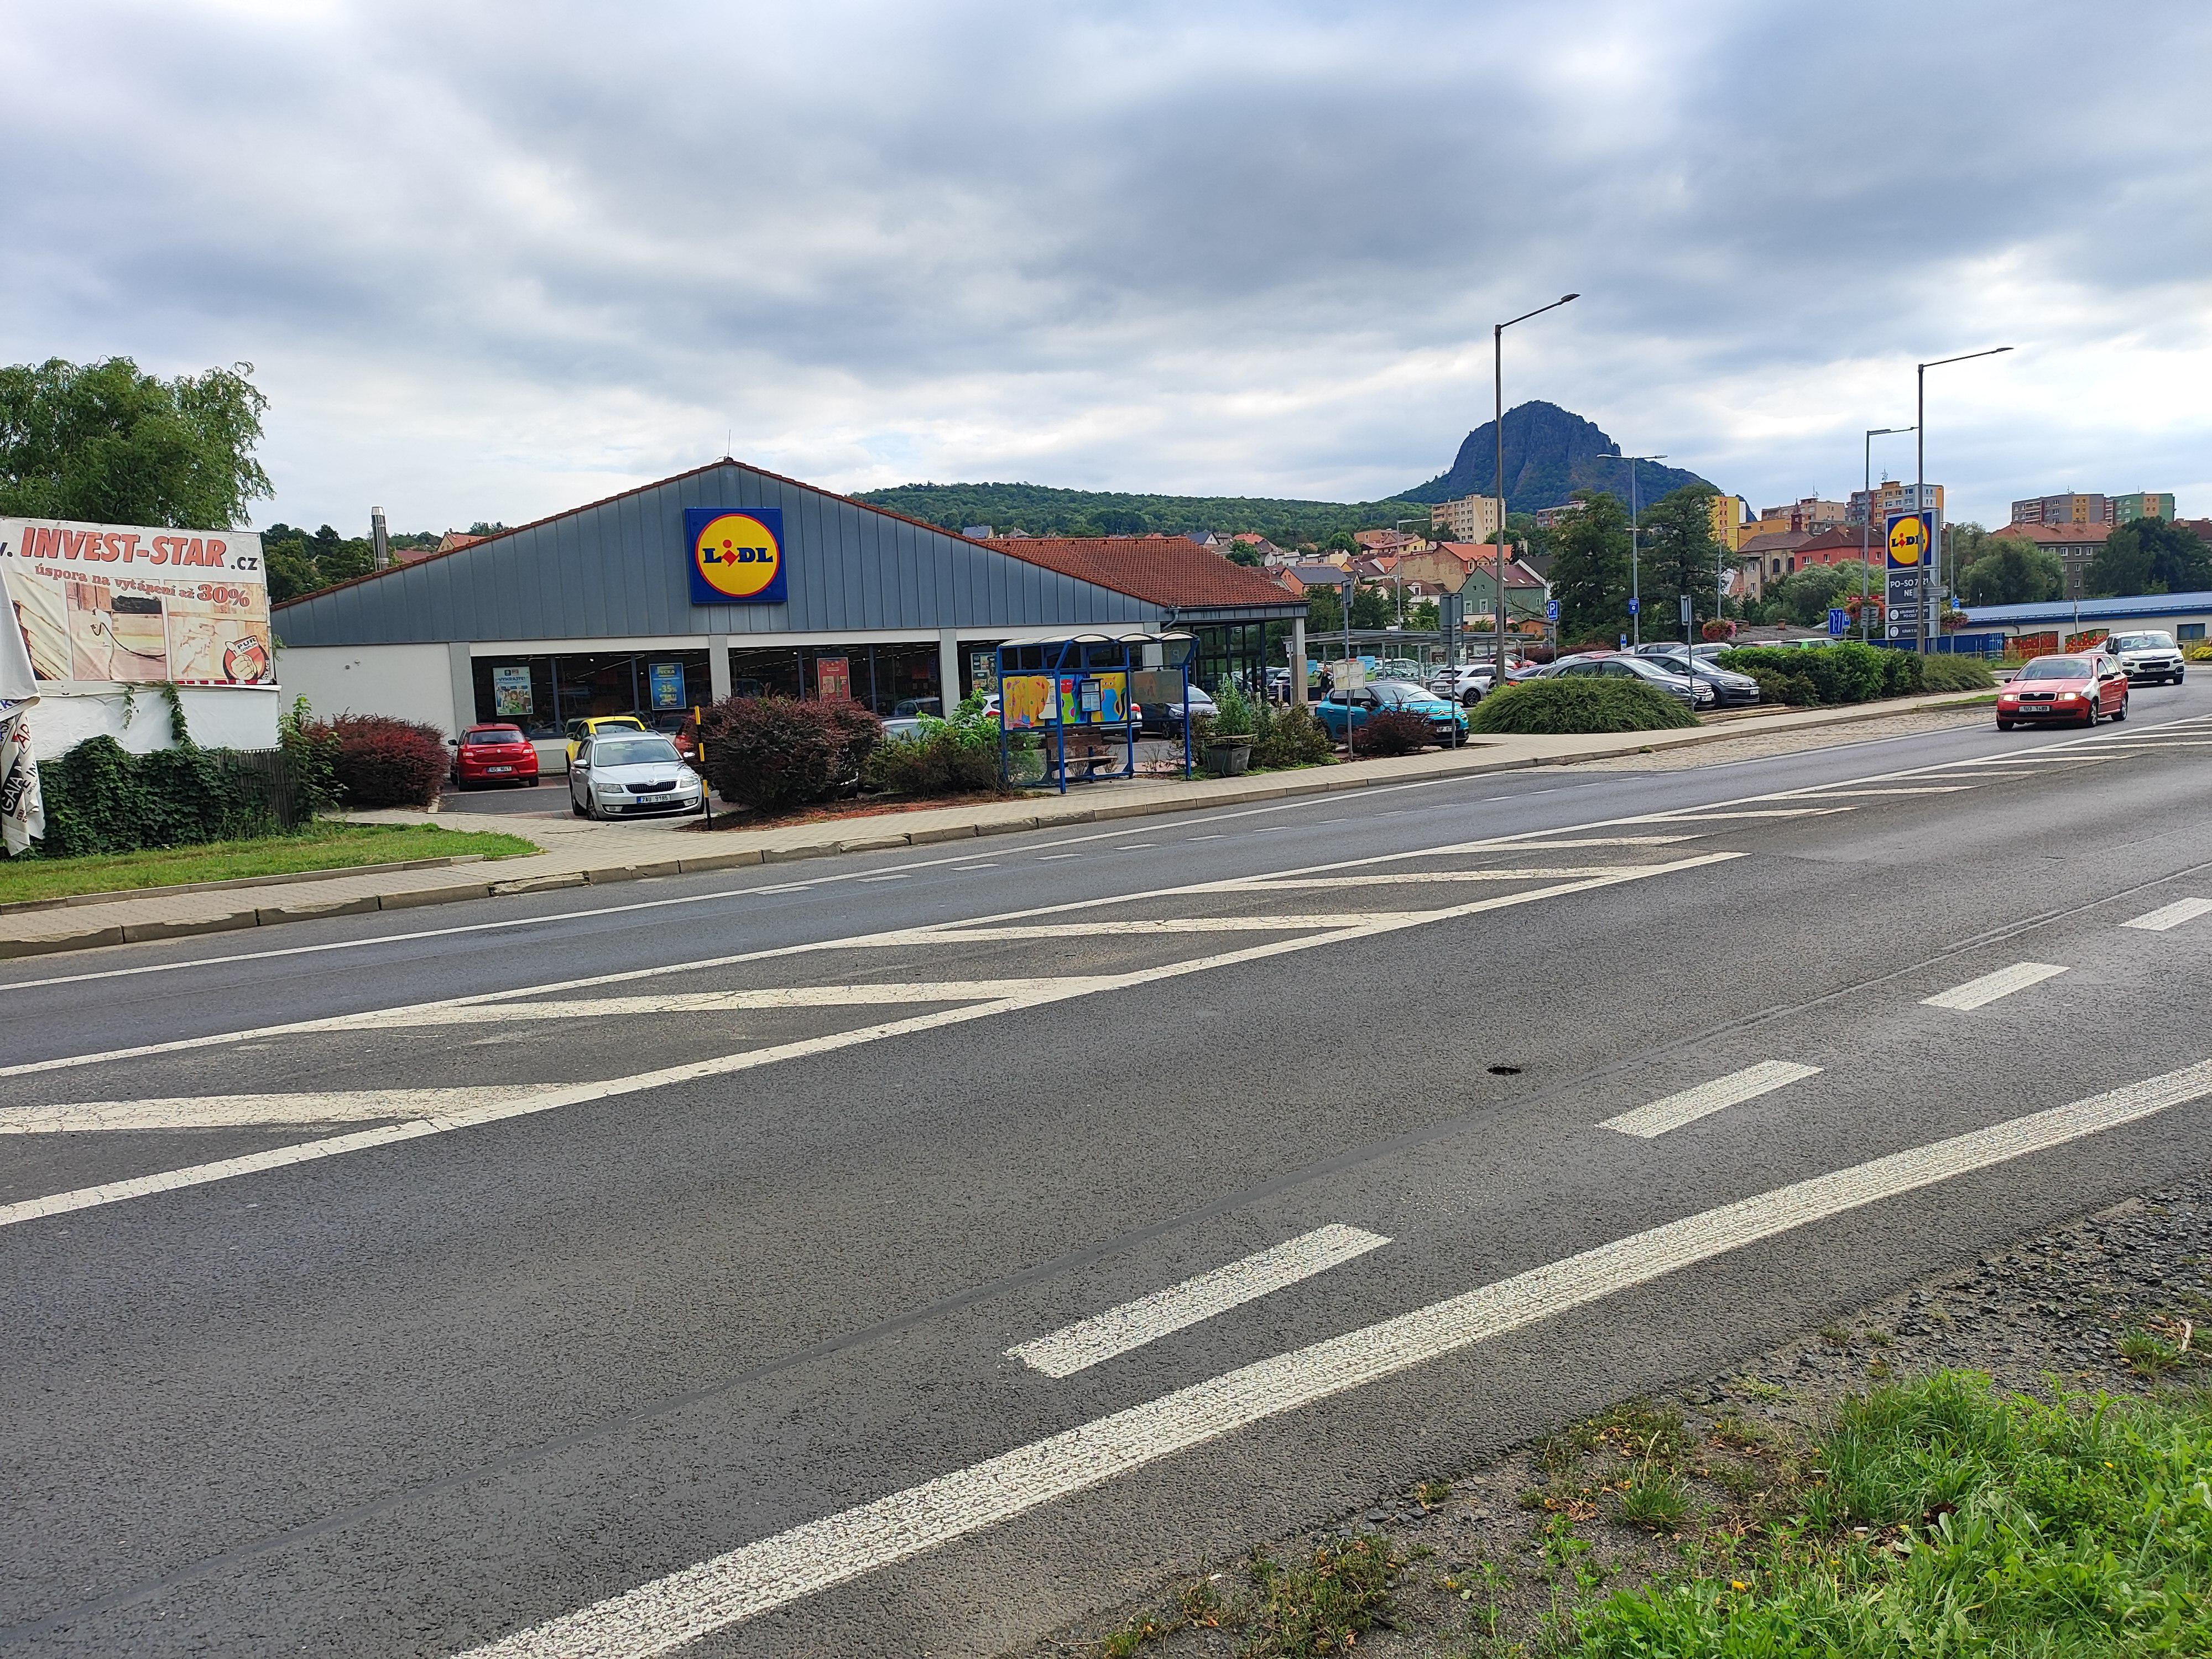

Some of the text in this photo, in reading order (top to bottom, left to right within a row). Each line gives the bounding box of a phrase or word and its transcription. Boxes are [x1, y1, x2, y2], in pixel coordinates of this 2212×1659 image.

[20, 526, 227, 568] INVEST-STAR
[702, 539, 774, 567] LIDL
[34, 562, 87, 583] úspora
[92, 575, 111, 586] na
[178, 587, 195, 599] až
[196, 583, 250, 607] 30%
[1890, 579, 1913, 588] PO-SO
[1550, 603, 1556, 614] P
[237, 638, 257, 650] PUR
